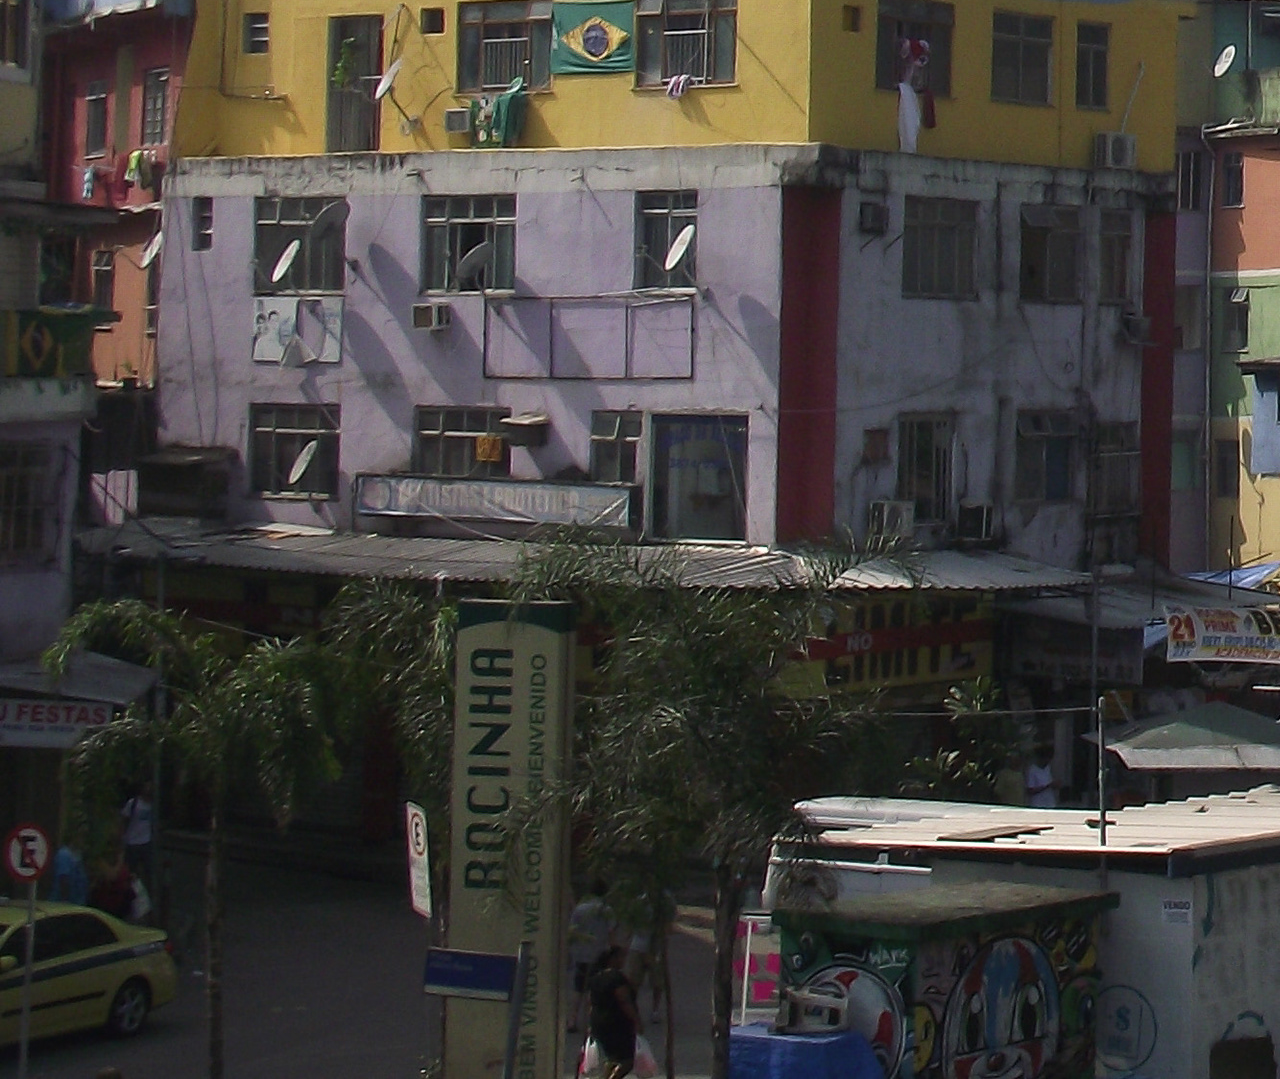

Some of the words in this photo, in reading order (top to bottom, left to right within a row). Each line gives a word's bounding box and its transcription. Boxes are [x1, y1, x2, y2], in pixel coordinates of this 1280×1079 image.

[846, 632, 873, 652] NO
[15, 703, 107, 725] FESTAS
[528, 653, 548, 795] BIENVENIDO
[464, 647, 514, 890] ROCINHA
[523, 817, 544, 934] WELCOME
[519, 1034, 536, 1079] BEM
